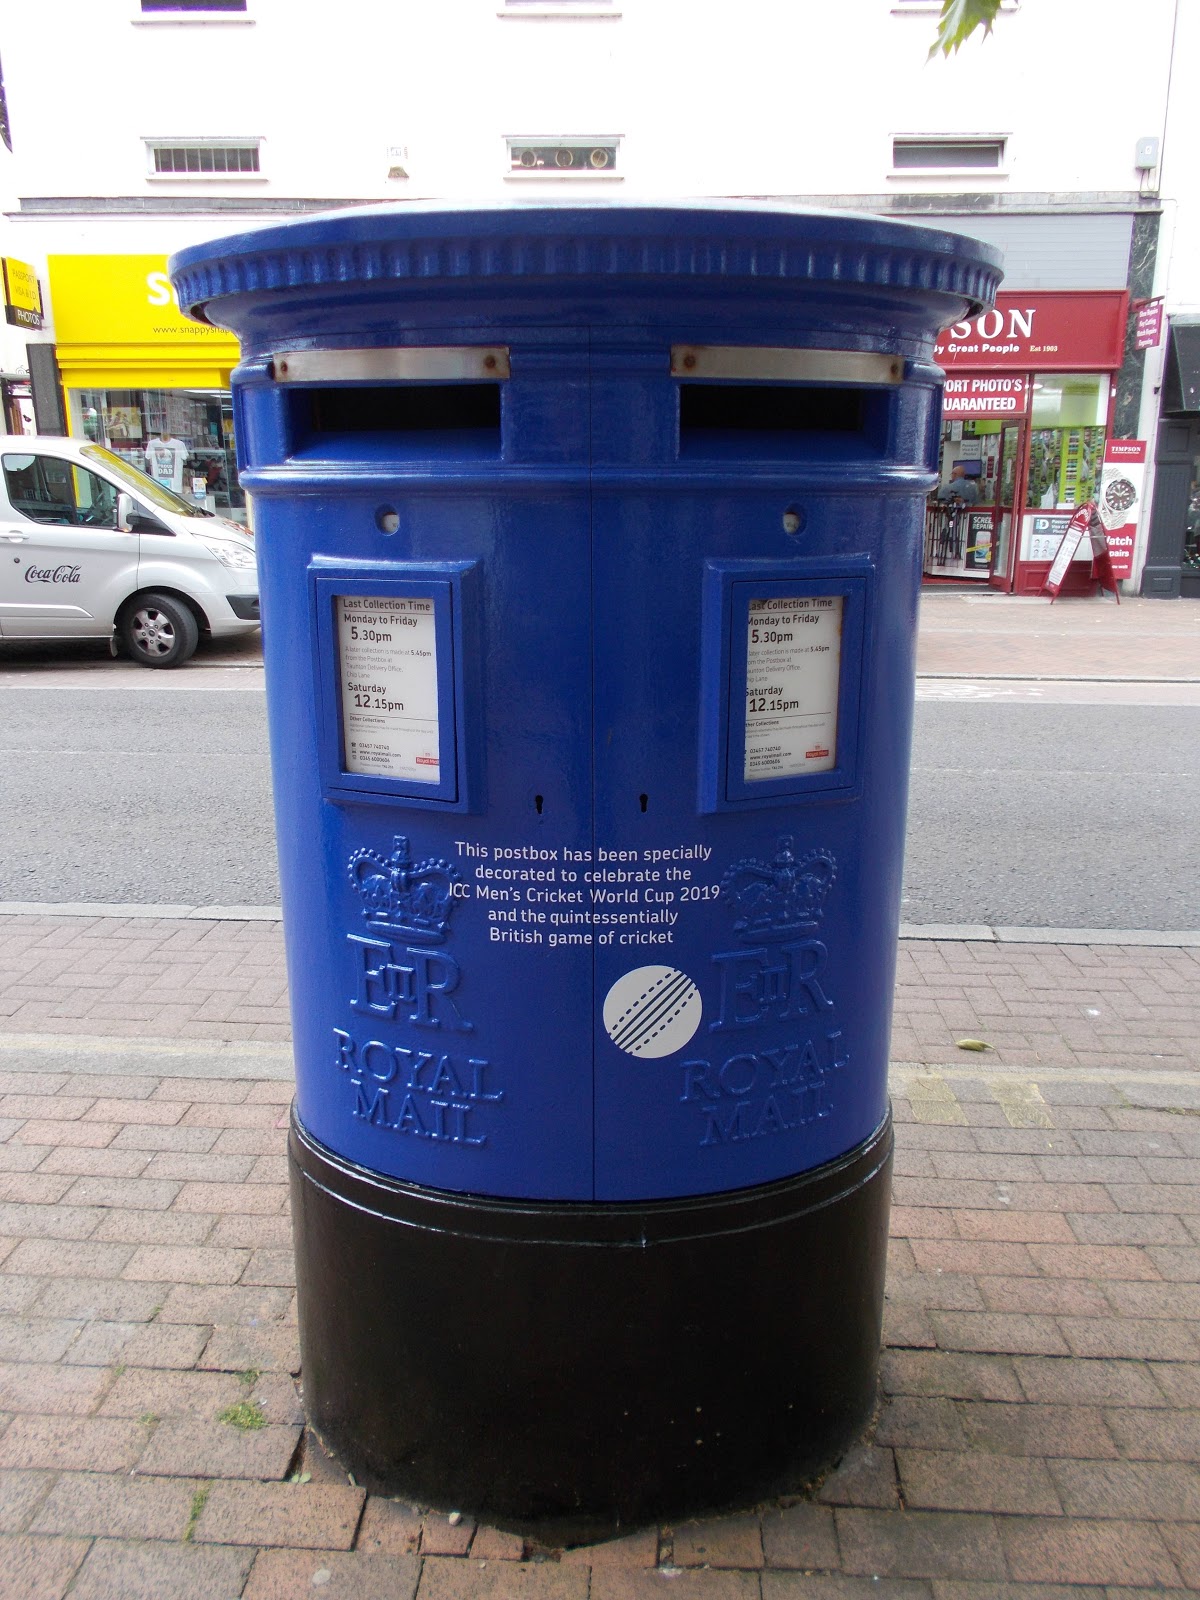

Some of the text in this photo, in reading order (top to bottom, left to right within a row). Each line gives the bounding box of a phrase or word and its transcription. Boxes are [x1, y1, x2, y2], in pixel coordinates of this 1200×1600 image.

[17, 309, 40, 326] PHOTOS
[950, 309, 1036, 339] SON
[153, 326, 230, 336] www.snappysnap
[948, 343, 979, 353] Great
[982, 343, 1020, 354] People
[944, 378, 1022, 392] ORT PHOTO'S
[943, 397, 1016, 411] UARANTEED
[973, 516, 992, 524] SCREE
[1109, 549, 1130, 558] pairs
[343, 598, 431, 611] Last Collection Time
[767, 600, 810, 610] Collection
[812, 598, 832, 607] Time
[344, 613, 418, 627] Monday to Friday
[782, 616, 791, 624] to
[792, 614, 820, 624] Friday
[351, 626, 392, 643] 5.30pm
[751, 629, 793, 644] 5.30pm
[411, 649, 432, 657] 5.45pm
[810, 645, 830, 653] 5.45pm
[347, 682, 387, 695] Saturday
[354, 694, 404, 711] 12.15pm
[749, 698, 799, 712] 12.15pm
[750, 752, 792, 760] www.royalmail.com
[454, 841, 712, 864] This postbox has been specially
[475, 864, 692, 882] decorated to celebrate the
[449, 882, 720, 905] ICC Men's Cricket World Cup 2019
[488, 908, 678, 926] and the quintessentially
[490, 926, 674, 947] British game of cricket
[333, 1027, 503, 1099] ROYAL
[680, 1030, 850, 1101] ROYAL
[351, 1078, 487, 1145] MAIL
[700, 1080, 834, 1146] MAIL
